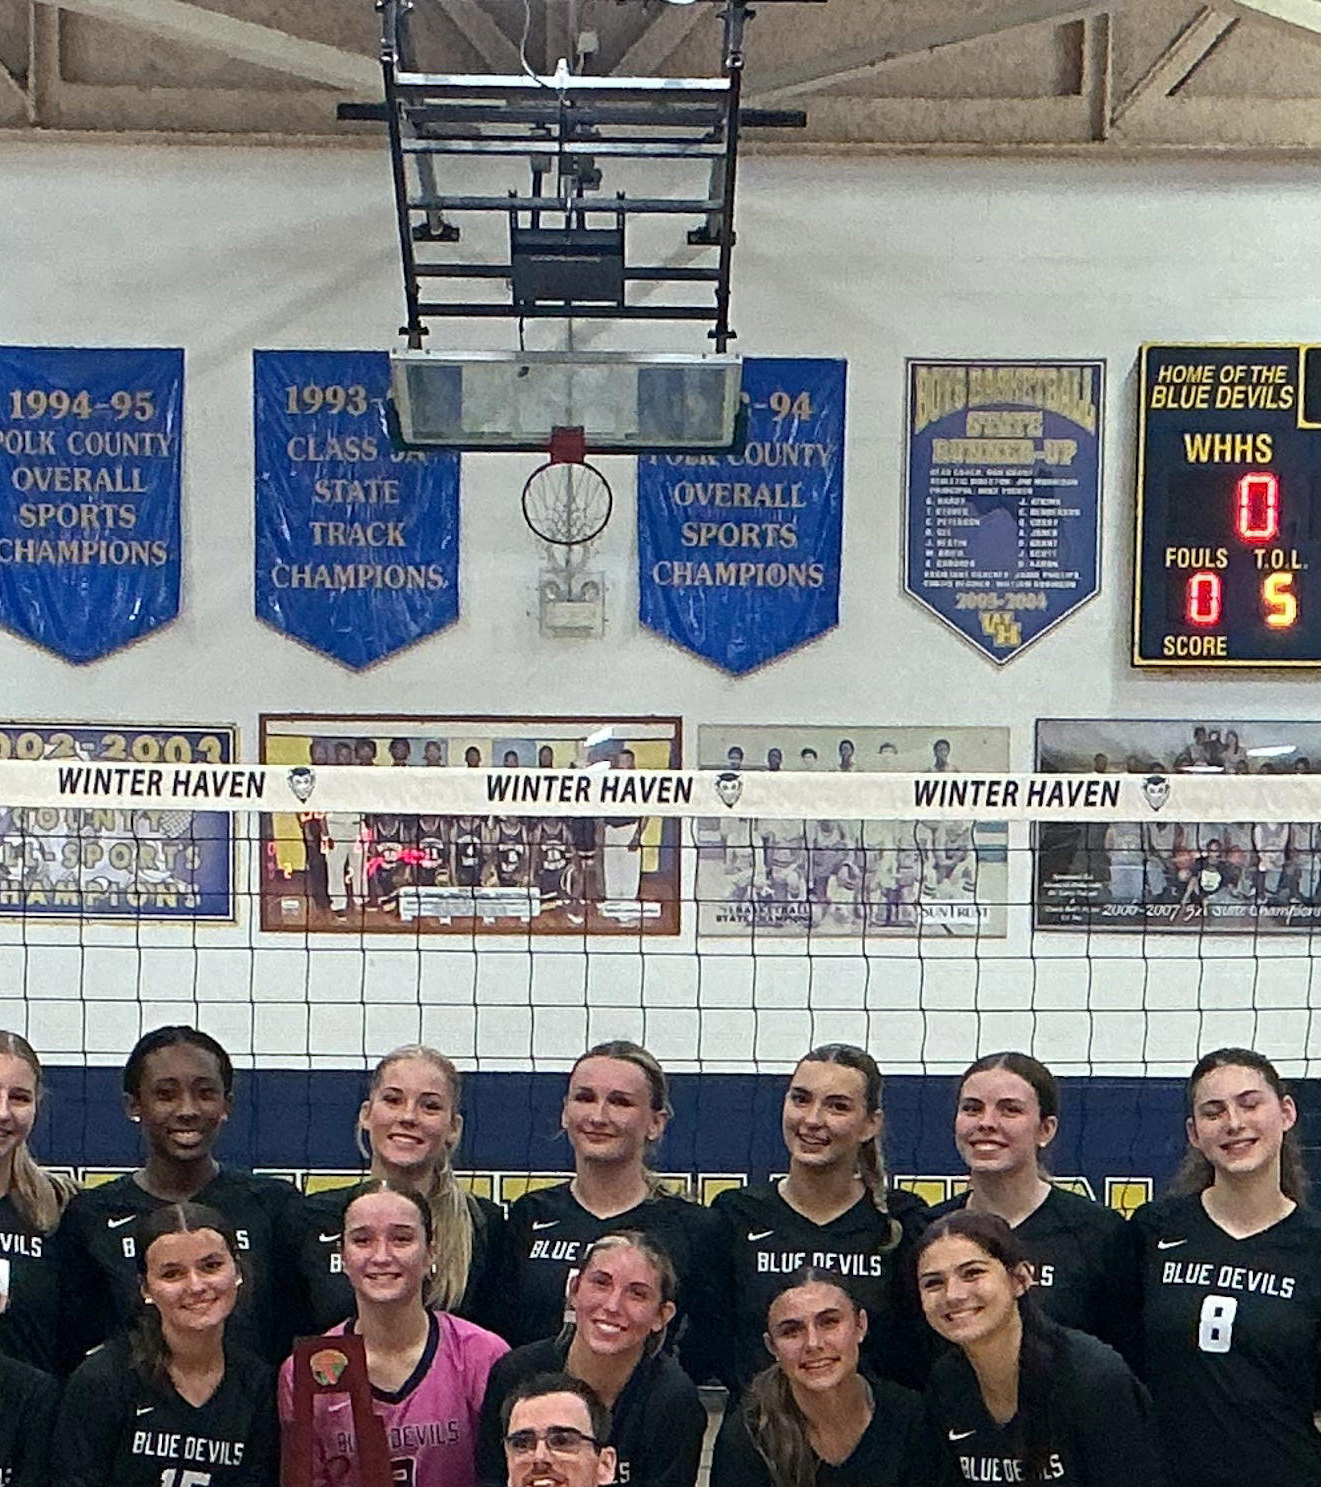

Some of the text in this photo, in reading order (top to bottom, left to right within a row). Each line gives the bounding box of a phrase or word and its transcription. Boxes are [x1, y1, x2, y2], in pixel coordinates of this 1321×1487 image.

[1158, 366, 1287, 385] HOME OF THE
[10, 390, 155, 422] 1994-95
[1152, 387, 1293, 410] BLUE DEVILS
[67, 431, 172, 457] COUNTY
[287, 436, 378, 462] CLASS
[1184, 434, 1274, 464] WHHS
[12, 467, 147, 493] OVERALL
[315, 479, 399, 504] STATE
[675, 483, 806, 509] OVERALL
[1238, 475, 1276, 542] 0
[19, 503, 137, 529] SPORTS
[310, 522, 406, 548] TRACK
[681, 522, 797, 549] SPORTS
[1165, 548, 1229, 569] FOULS
[1254, 548, 1309, 570] T.O.L.
[271, 562, 445, 590] CHAMPIONS
[652, 561, 824, 588] CHAMPIONS
[1189, 571, 1221, 625] 0
[1262, 573, 1297, 629] 5
[1164, 636, 1227, 657] SCORE
[58, 767, 266, 799] WINTER HAVEN
[487, 774, 694, 804] WINTER HAVEN
[915, 780, 1121, 808] WINTER HAVEN
[529, 1240, 580, 1261] BLUE
[757, 1251, 882, 1277] BLUE DEVILS
[1162, 1262, 1295, 1299] BLUE DEVILS
[1198, 1295, 1238, 1353] 8
[390, 1420, 460, 1449] DEVILS
[132, 1431, 244, 1466] BLUE DEVILS
[959, 1456, 1002, 1481] BLUE
